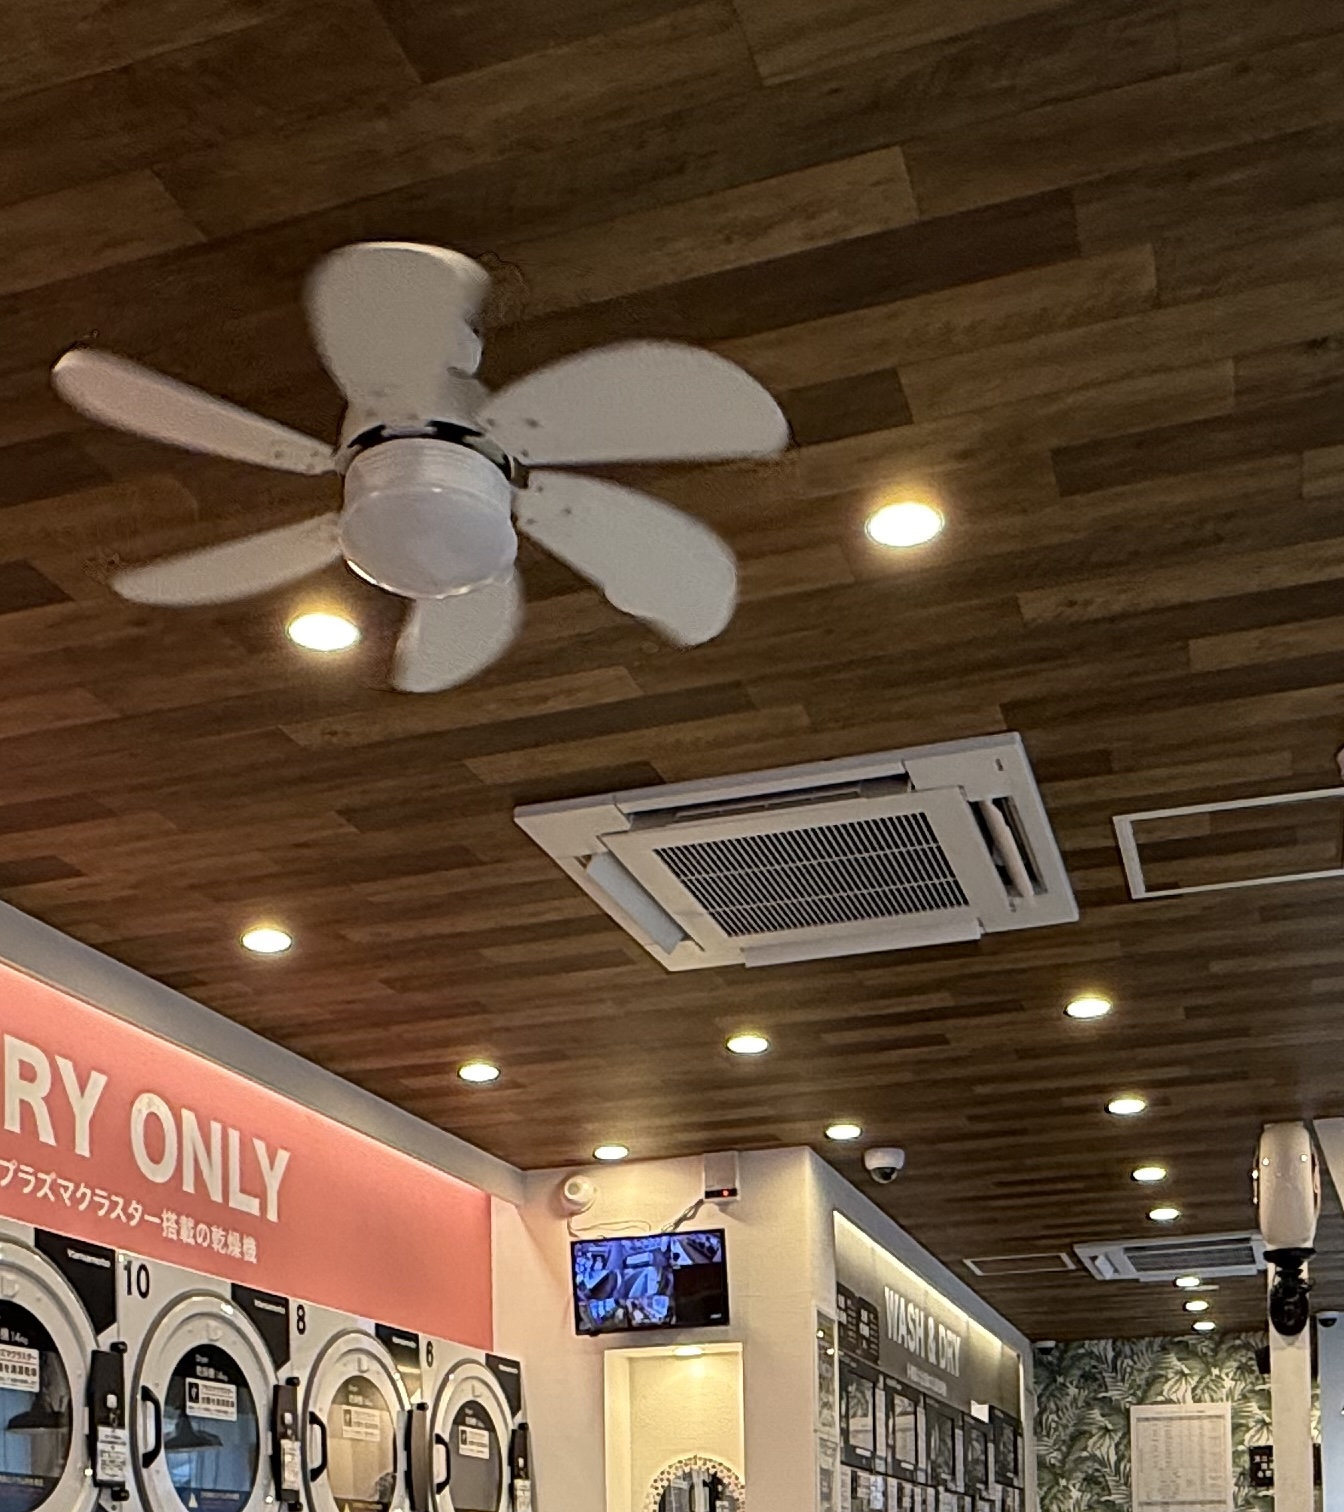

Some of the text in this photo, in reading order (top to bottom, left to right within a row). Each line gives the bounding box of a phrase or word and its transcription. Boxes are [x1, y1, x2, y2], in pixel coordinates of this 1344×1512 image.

[130, 1092, 291, 1223] ONLY
[124, 1261, 150, 1299] 10
[296, 1304, 306, 1335] 8
[884, 1286, 925, 1358] WASH
[927, 1316, 938, 1365] &
[938, 1323, 961, 1378] DRY
[425, 1340, 434, 1368] 6
